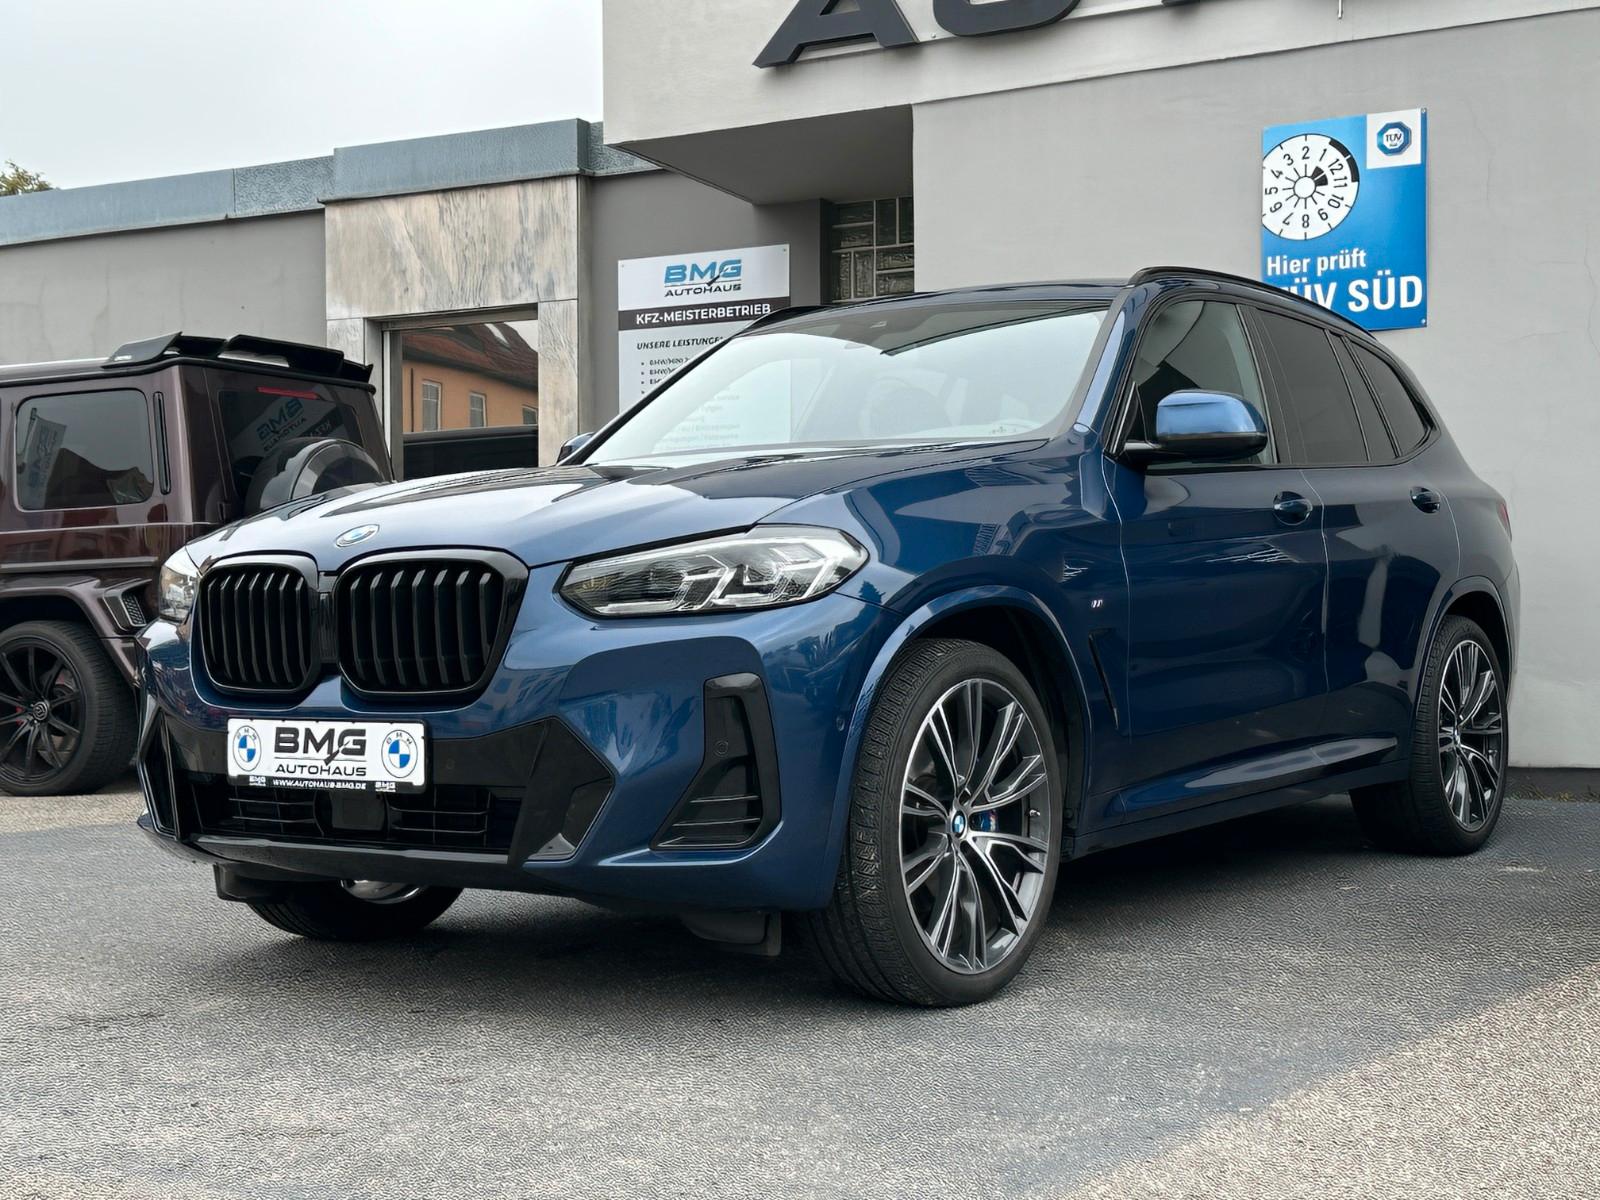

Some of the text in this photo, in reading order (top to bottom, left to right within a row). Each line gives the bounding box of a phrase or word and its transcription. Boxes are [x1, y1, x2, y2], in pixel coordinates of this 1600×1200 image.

[1283, 153, 1294, 166] 3
[1302, 146, 1310, 160] 2
[1319, 148, 1327, 161] 1
[1328, 158, 1344, 175] 12
[1271, 169, 1283, 179] 4
[1333, 176, 1347, 188] 11
[1265, 187, 1278, 195] 5
[1269, 202, 1282, 213] 6
[1327, 194, 1344, 209] 10
[1282, 212, 1294, 226] 7
[1302, 214, 1309, 228] 8
[1317, 208, 1328, 221] 9
[1266, 247, 1366, 276] Hier prüft
[664, 259, 742, 284] BMG
[664, 283, 741, 298] AUTOHAUS
[1348, 269, 1423, 312] SÜD
[636, 303, 771, 325] KFZ-MEISTERBETRIEB
[637, 336, 723, 350] UNSERE LEISTUNGE
[274, 727, 366, 757] BMG
[275, 763, 367, 777] AUTOHAUS
